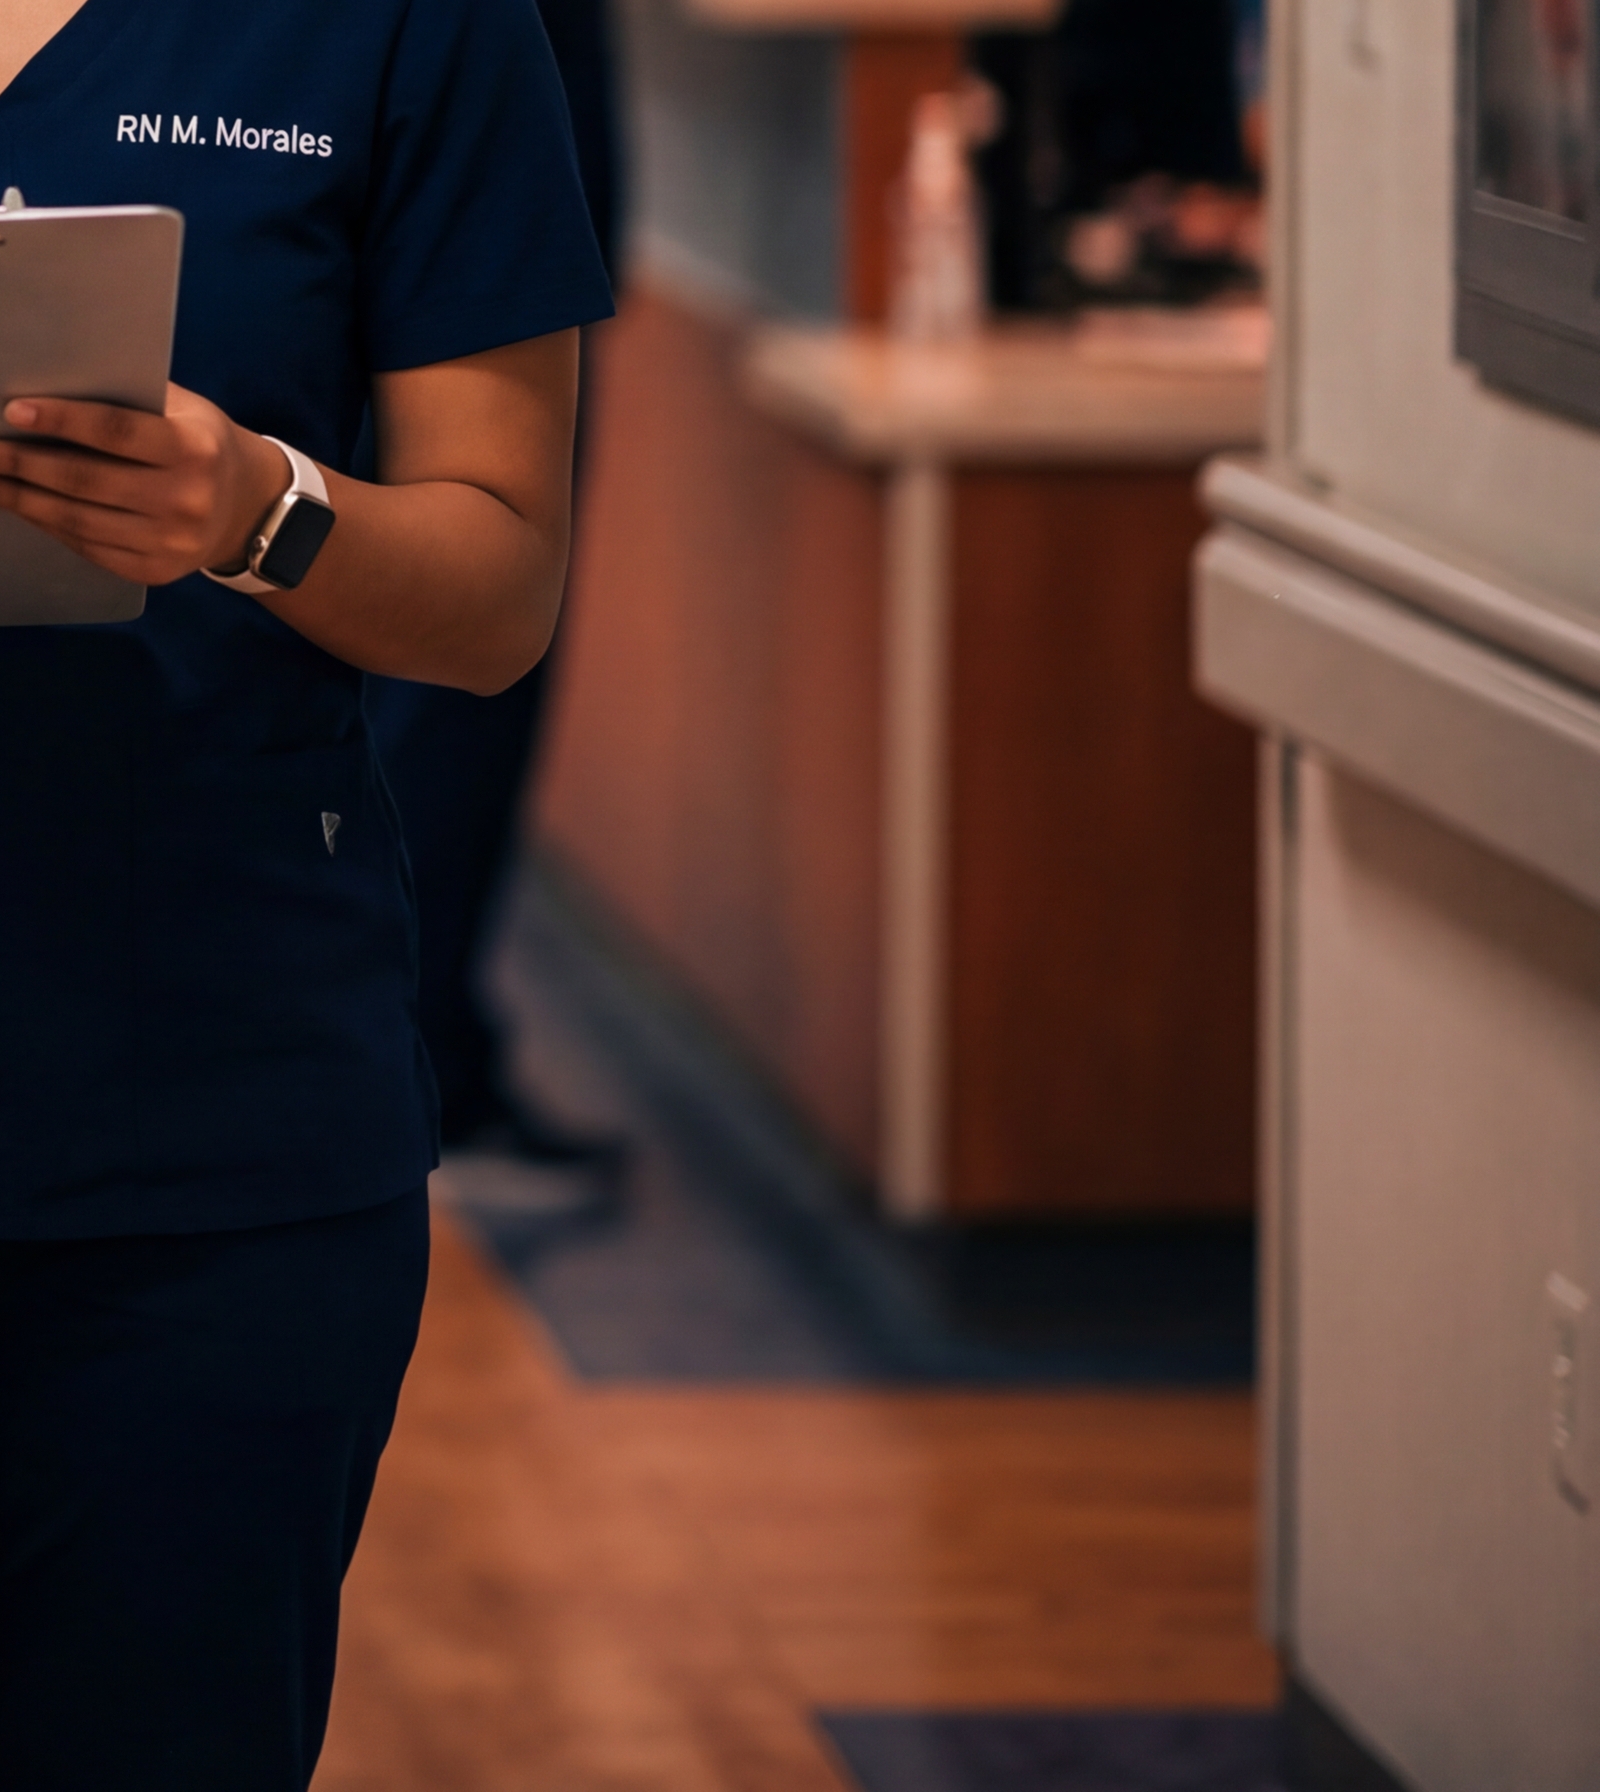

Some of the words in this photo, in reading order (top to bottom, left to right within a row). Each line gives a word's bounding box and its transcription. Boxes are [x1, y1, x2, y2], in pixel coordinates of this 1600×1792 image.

[116, 113, 162, 144] RN
[171, 115, 206, 145] M.
[216, 117, 333, 157] Morales
